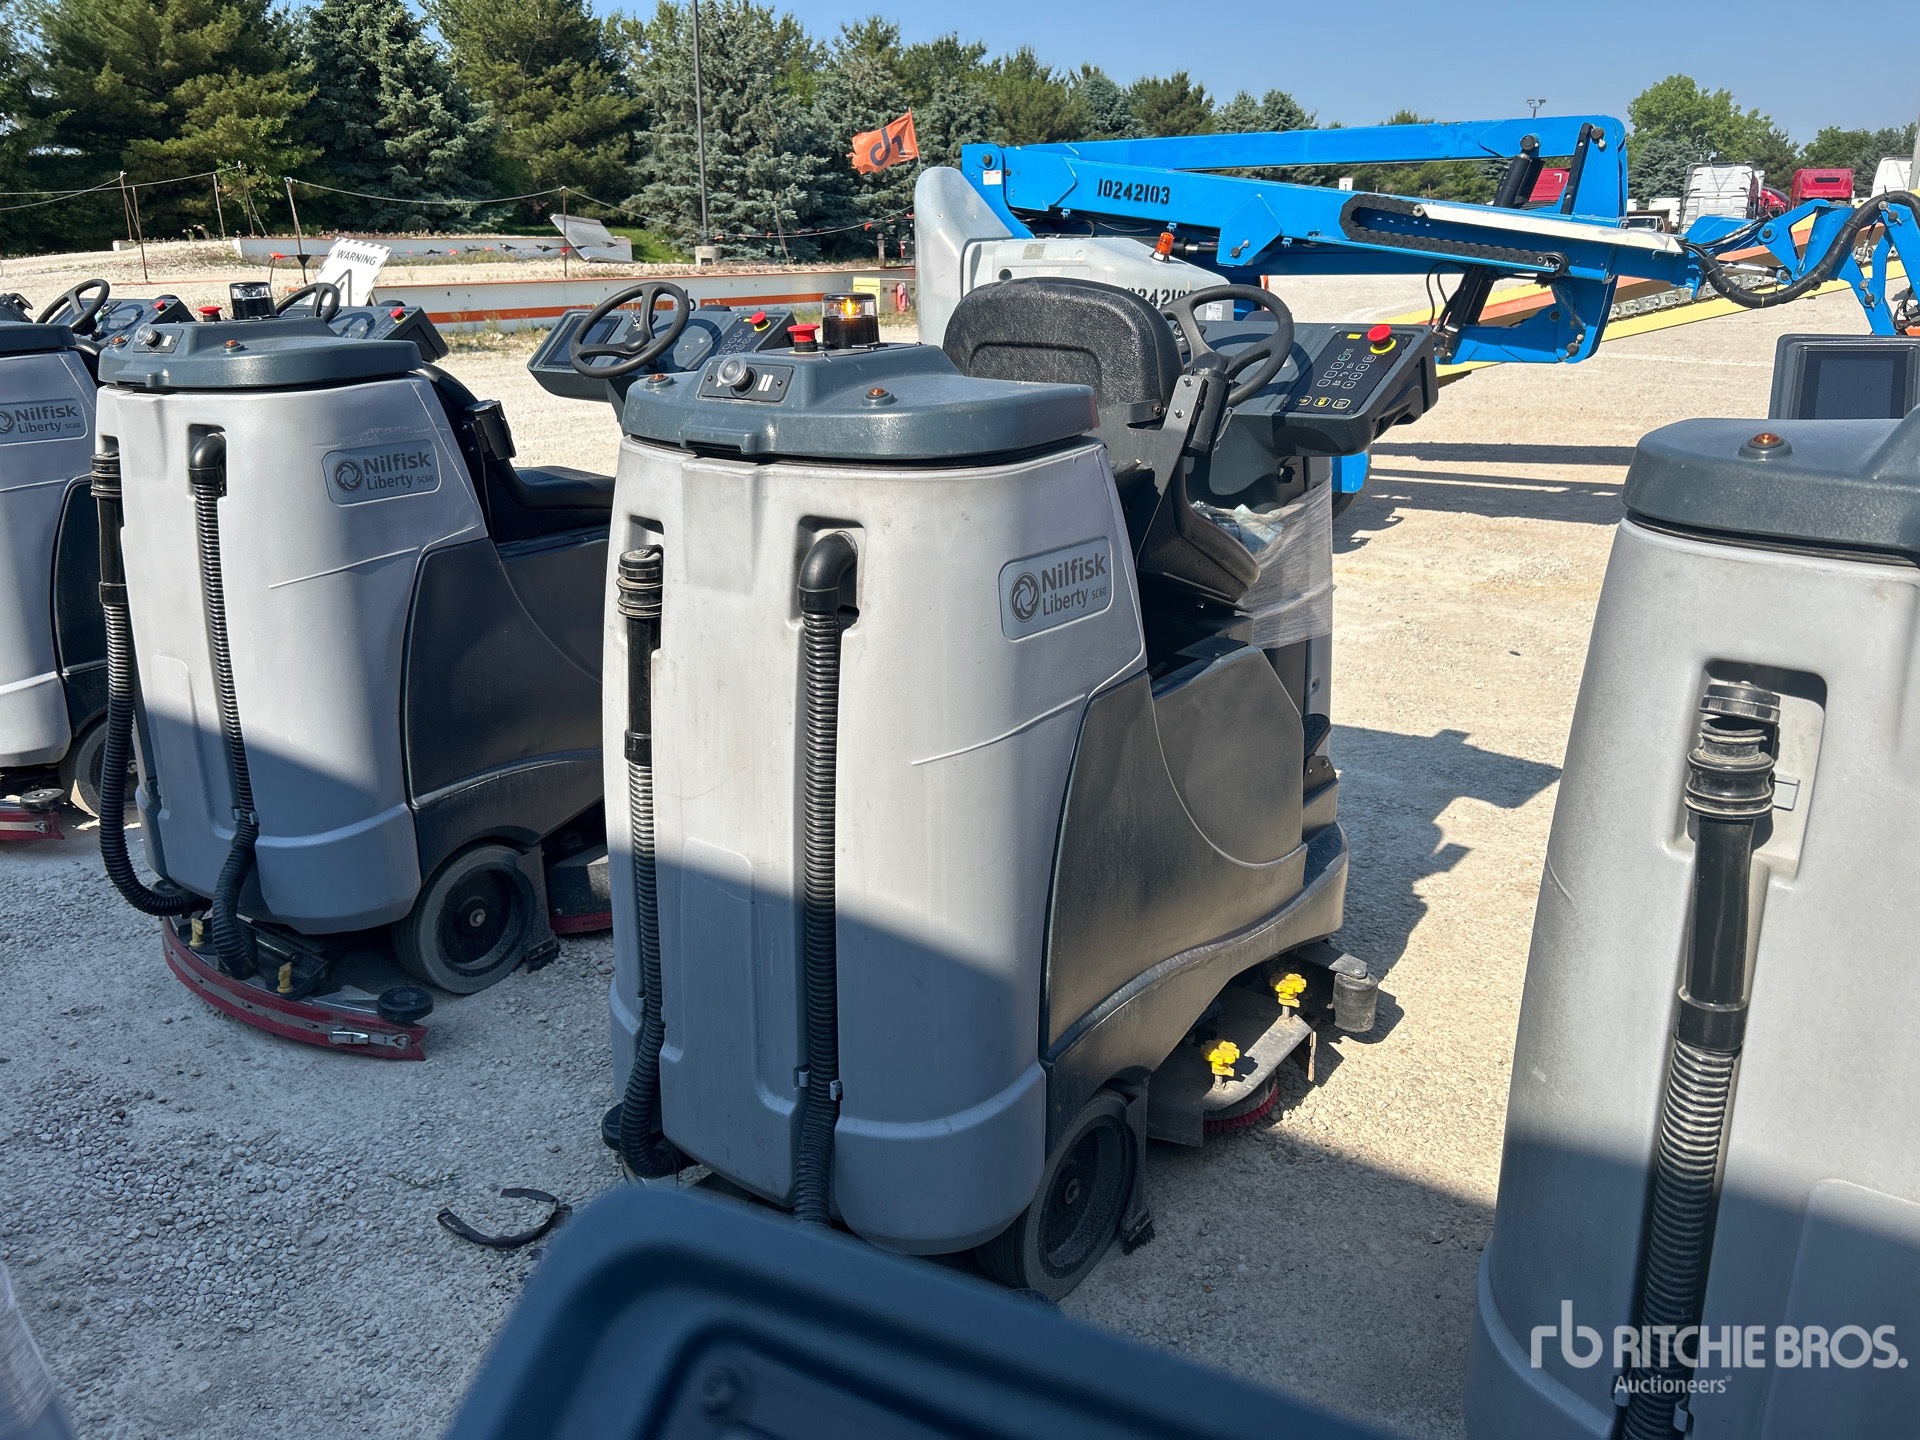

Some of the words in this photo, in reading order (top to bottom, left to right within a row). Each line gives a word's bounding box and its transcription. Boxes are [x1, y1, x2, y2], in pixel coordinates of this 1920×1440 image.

[1097, 179, 1170, 204] 10242103
[337, 249, 377, 265] WARNING
[15, 405, 78, 421] Nilfisk
[18, 421, 62, 434] Liberty
[363, 451, 432, 475] Nilfisk
[366, 474, 413, 491] Liberty
[1041, 553, 1106, 593] Nilfisk
[1043, 588, 1088, 615] Liberty
[1092, 586, 1106, 600] SC60
